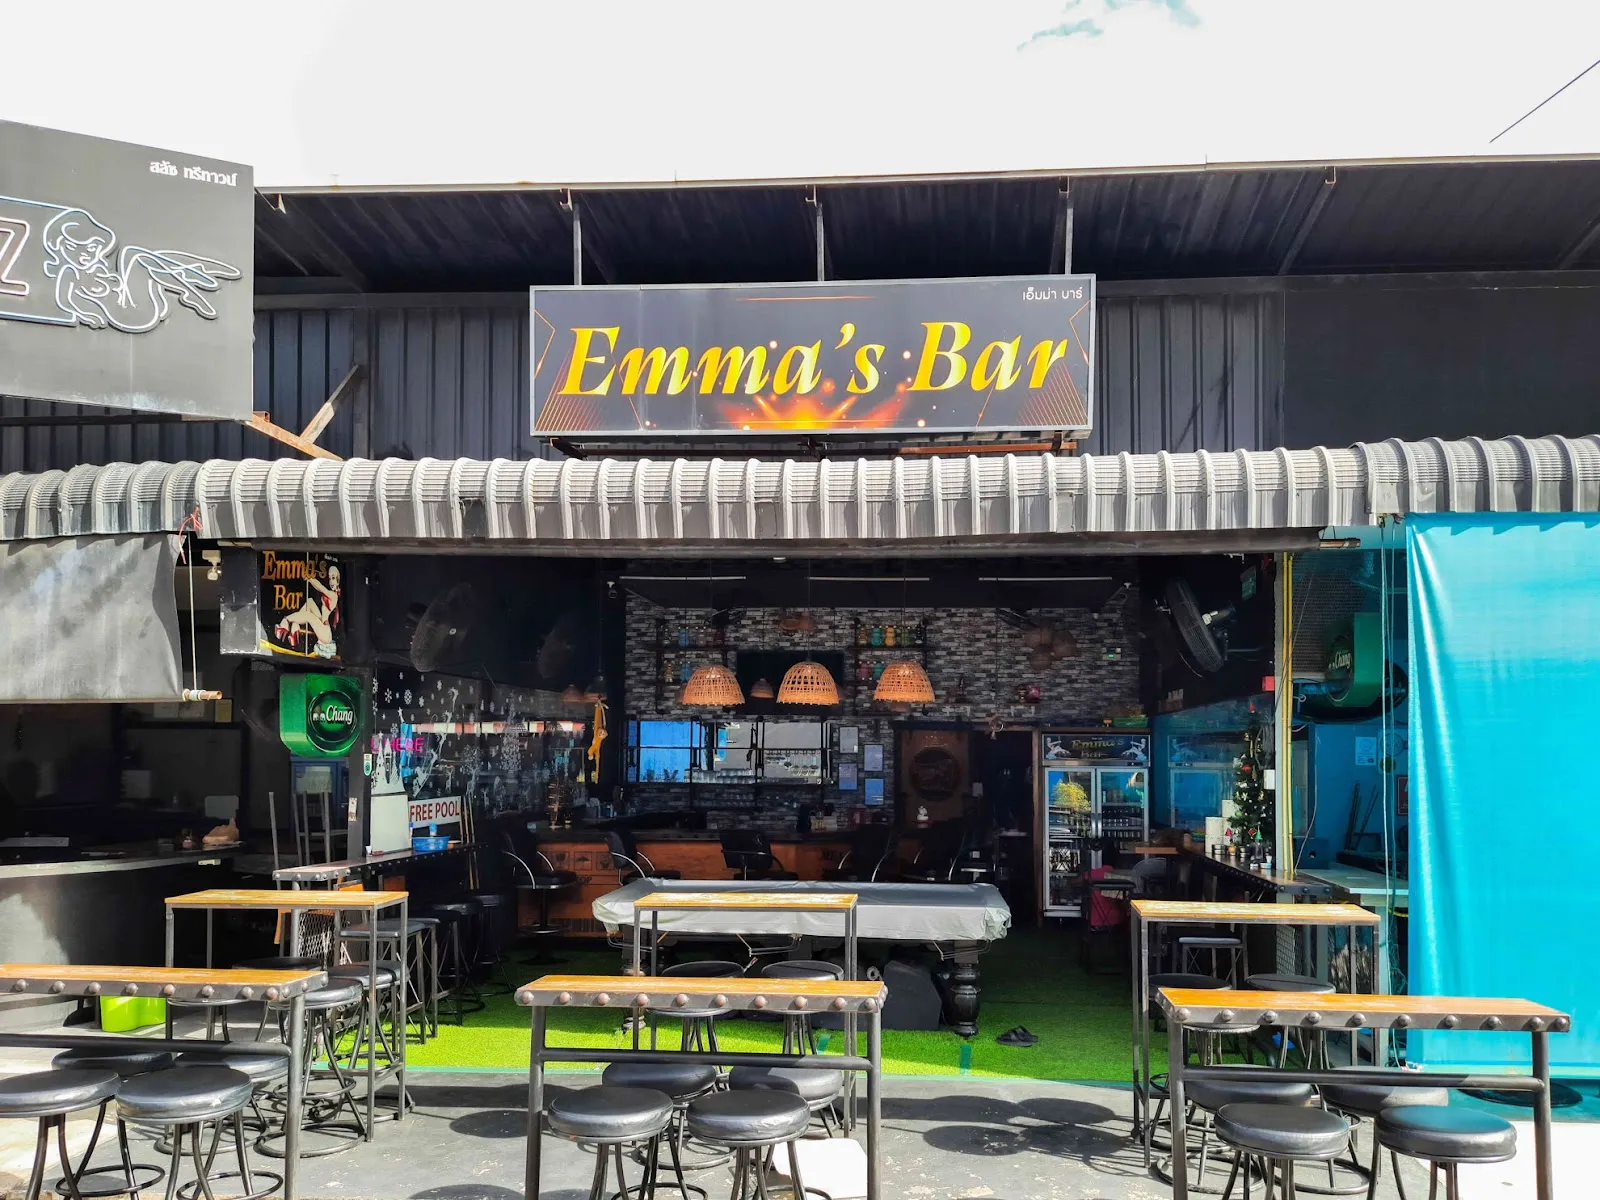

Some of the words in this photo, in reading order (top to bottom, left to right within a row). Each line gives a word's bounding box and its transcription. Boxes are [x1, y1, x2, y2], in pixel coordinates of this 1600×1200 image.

[1022, 281, 1057, 301] เอ็มม่า
[1061, 281, 1084, 300] บาร์
[557, 322, 886, 396] Emma's
[909, 320, 1068, 392] Bar
[262, 551, 328, 581] Emma's
[273, 584, 304, 611] Bar
[1335, 651, 1351, 669] Chang
[326, 704, 353, 725] Chang
[409, 803, 433, 822] FREE
[435, 800, 460, 820] POOL
